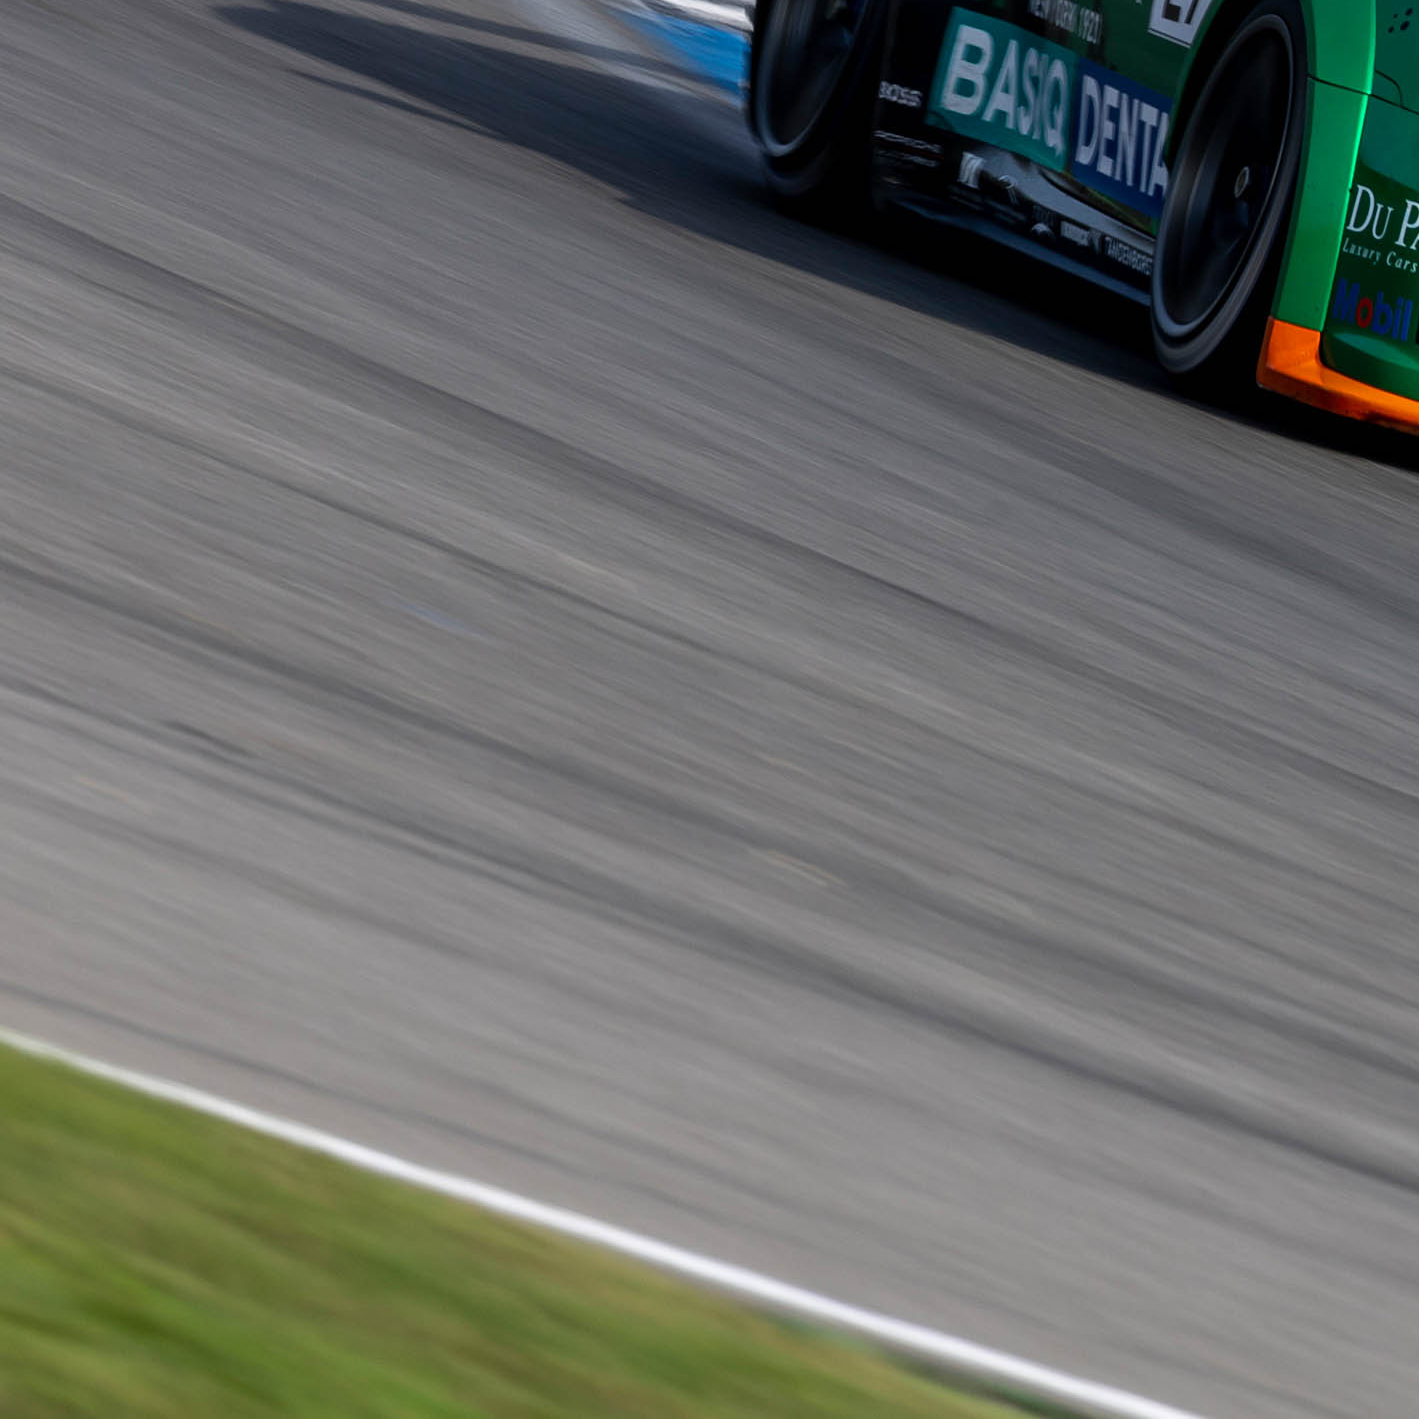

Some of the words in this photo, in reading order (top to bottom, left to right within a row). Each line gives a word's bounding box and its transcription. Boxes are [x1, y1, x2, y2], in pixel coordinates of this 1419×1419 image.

[941, 23, 1067, 157] BASIQ
[1075, 74, 1169, 198] DENTA
[1342, 238, 1381, 266] Luxury
[1386, 251, 1418, 273] Cars
[1332, 277, 1414, 342] Mobil
